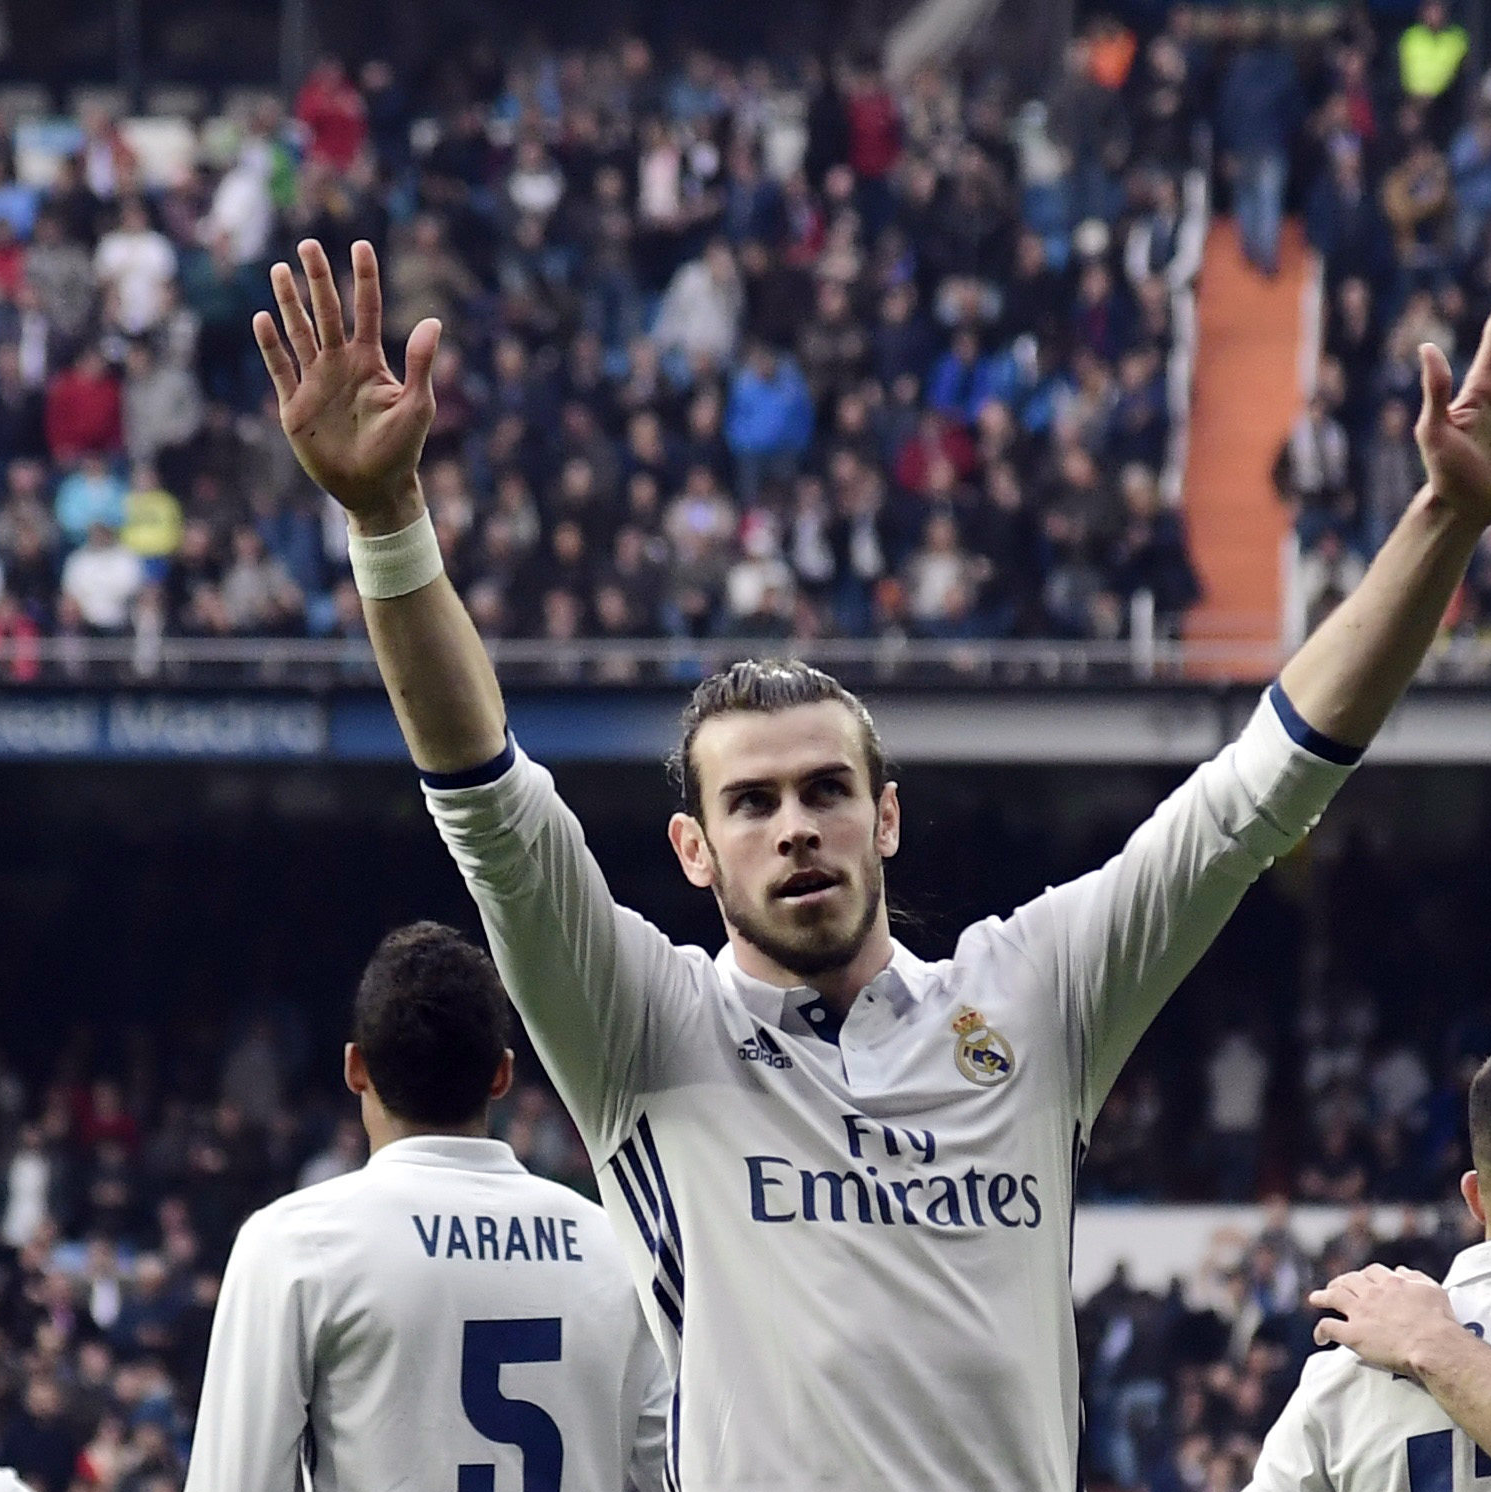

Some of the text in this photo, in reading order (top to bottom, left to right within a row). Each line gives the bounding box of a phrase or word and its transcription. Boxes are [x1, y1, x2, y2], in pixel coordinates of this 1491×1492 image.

[737, 1047, 794, 1070] adidas
[841, 1113, 937, 1164] Fly
[744, 1156, 1042, 1230] Emirates
[412, 1214, 583, 1262] VARANE
